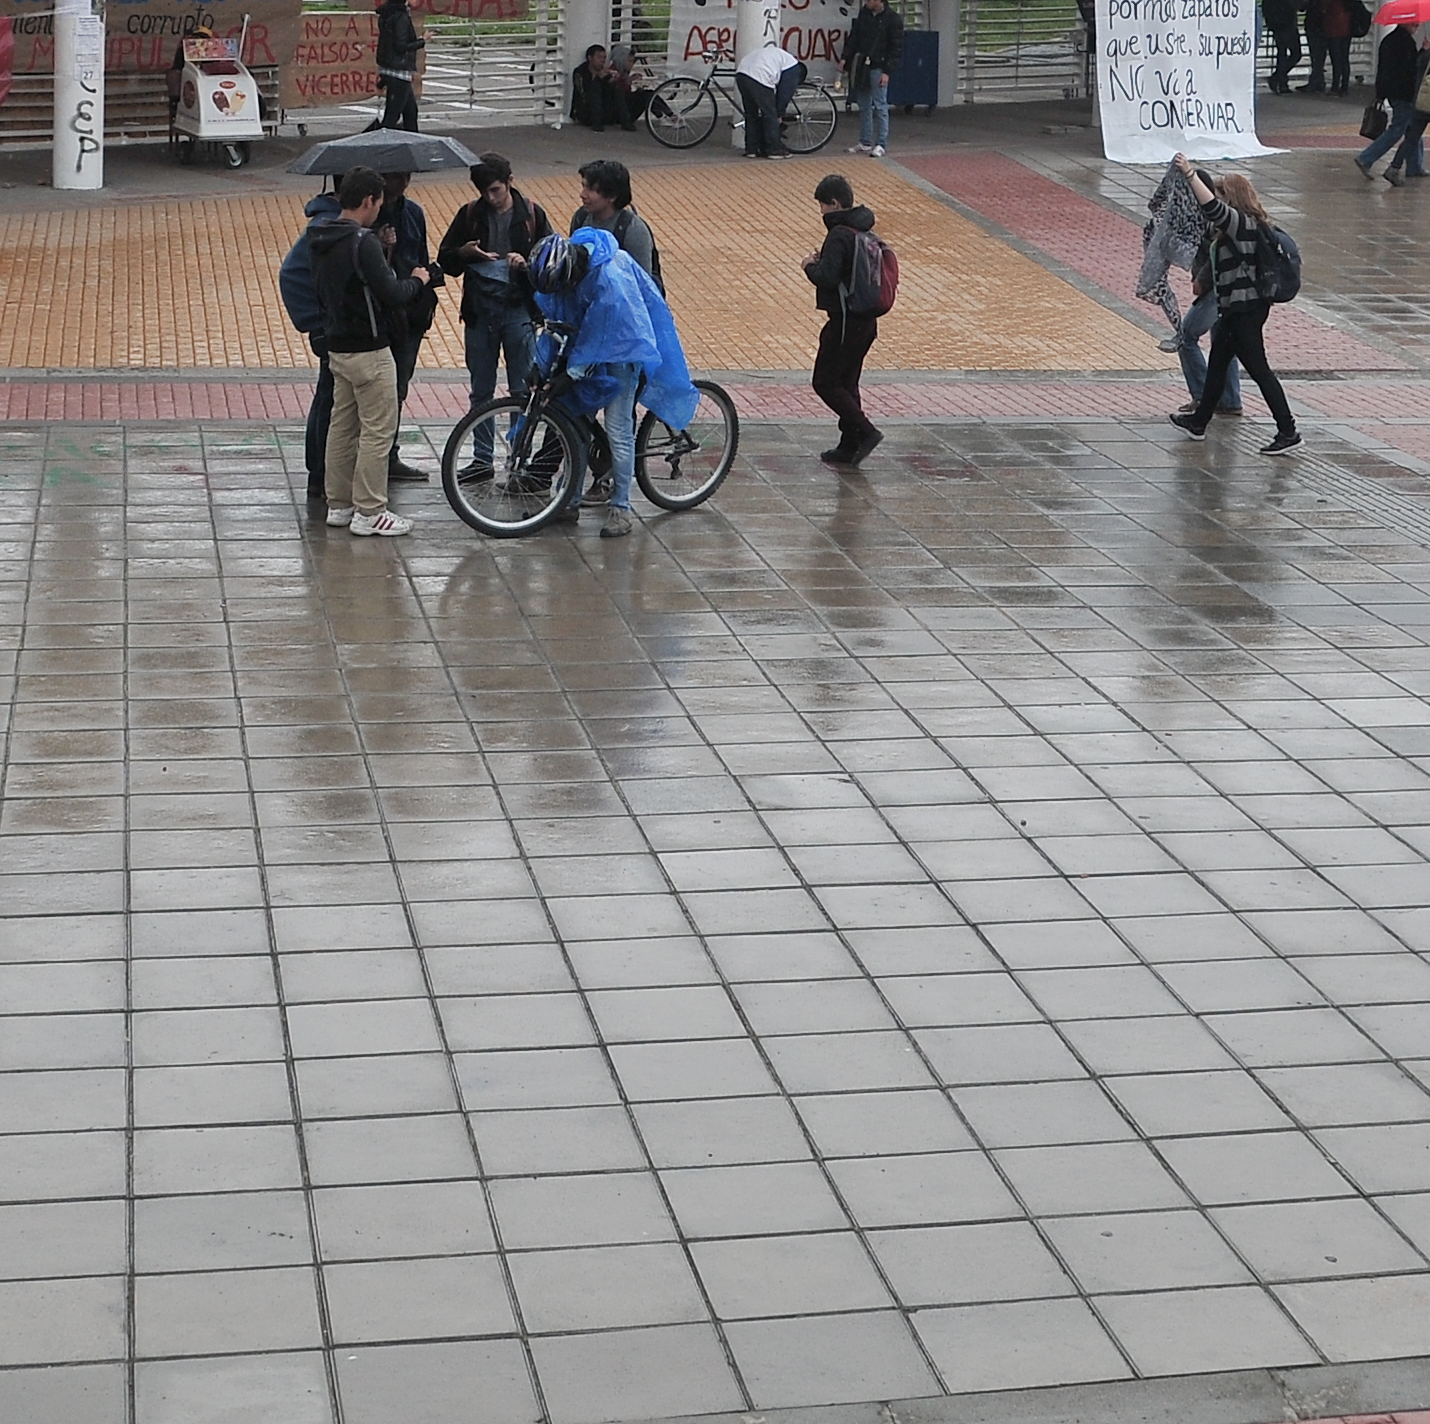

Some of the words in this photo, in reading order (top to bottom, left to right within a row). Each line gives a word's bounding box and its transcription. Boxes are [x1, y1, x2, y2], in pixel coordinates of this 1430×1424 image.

[127, 4, 215, 37] corrupto
[305, 16, 332, 40] NO
[345, 16, 360, 39] A
[294, 41, 363, 67] FALSOS
[83, 71, 94, 80] 27
